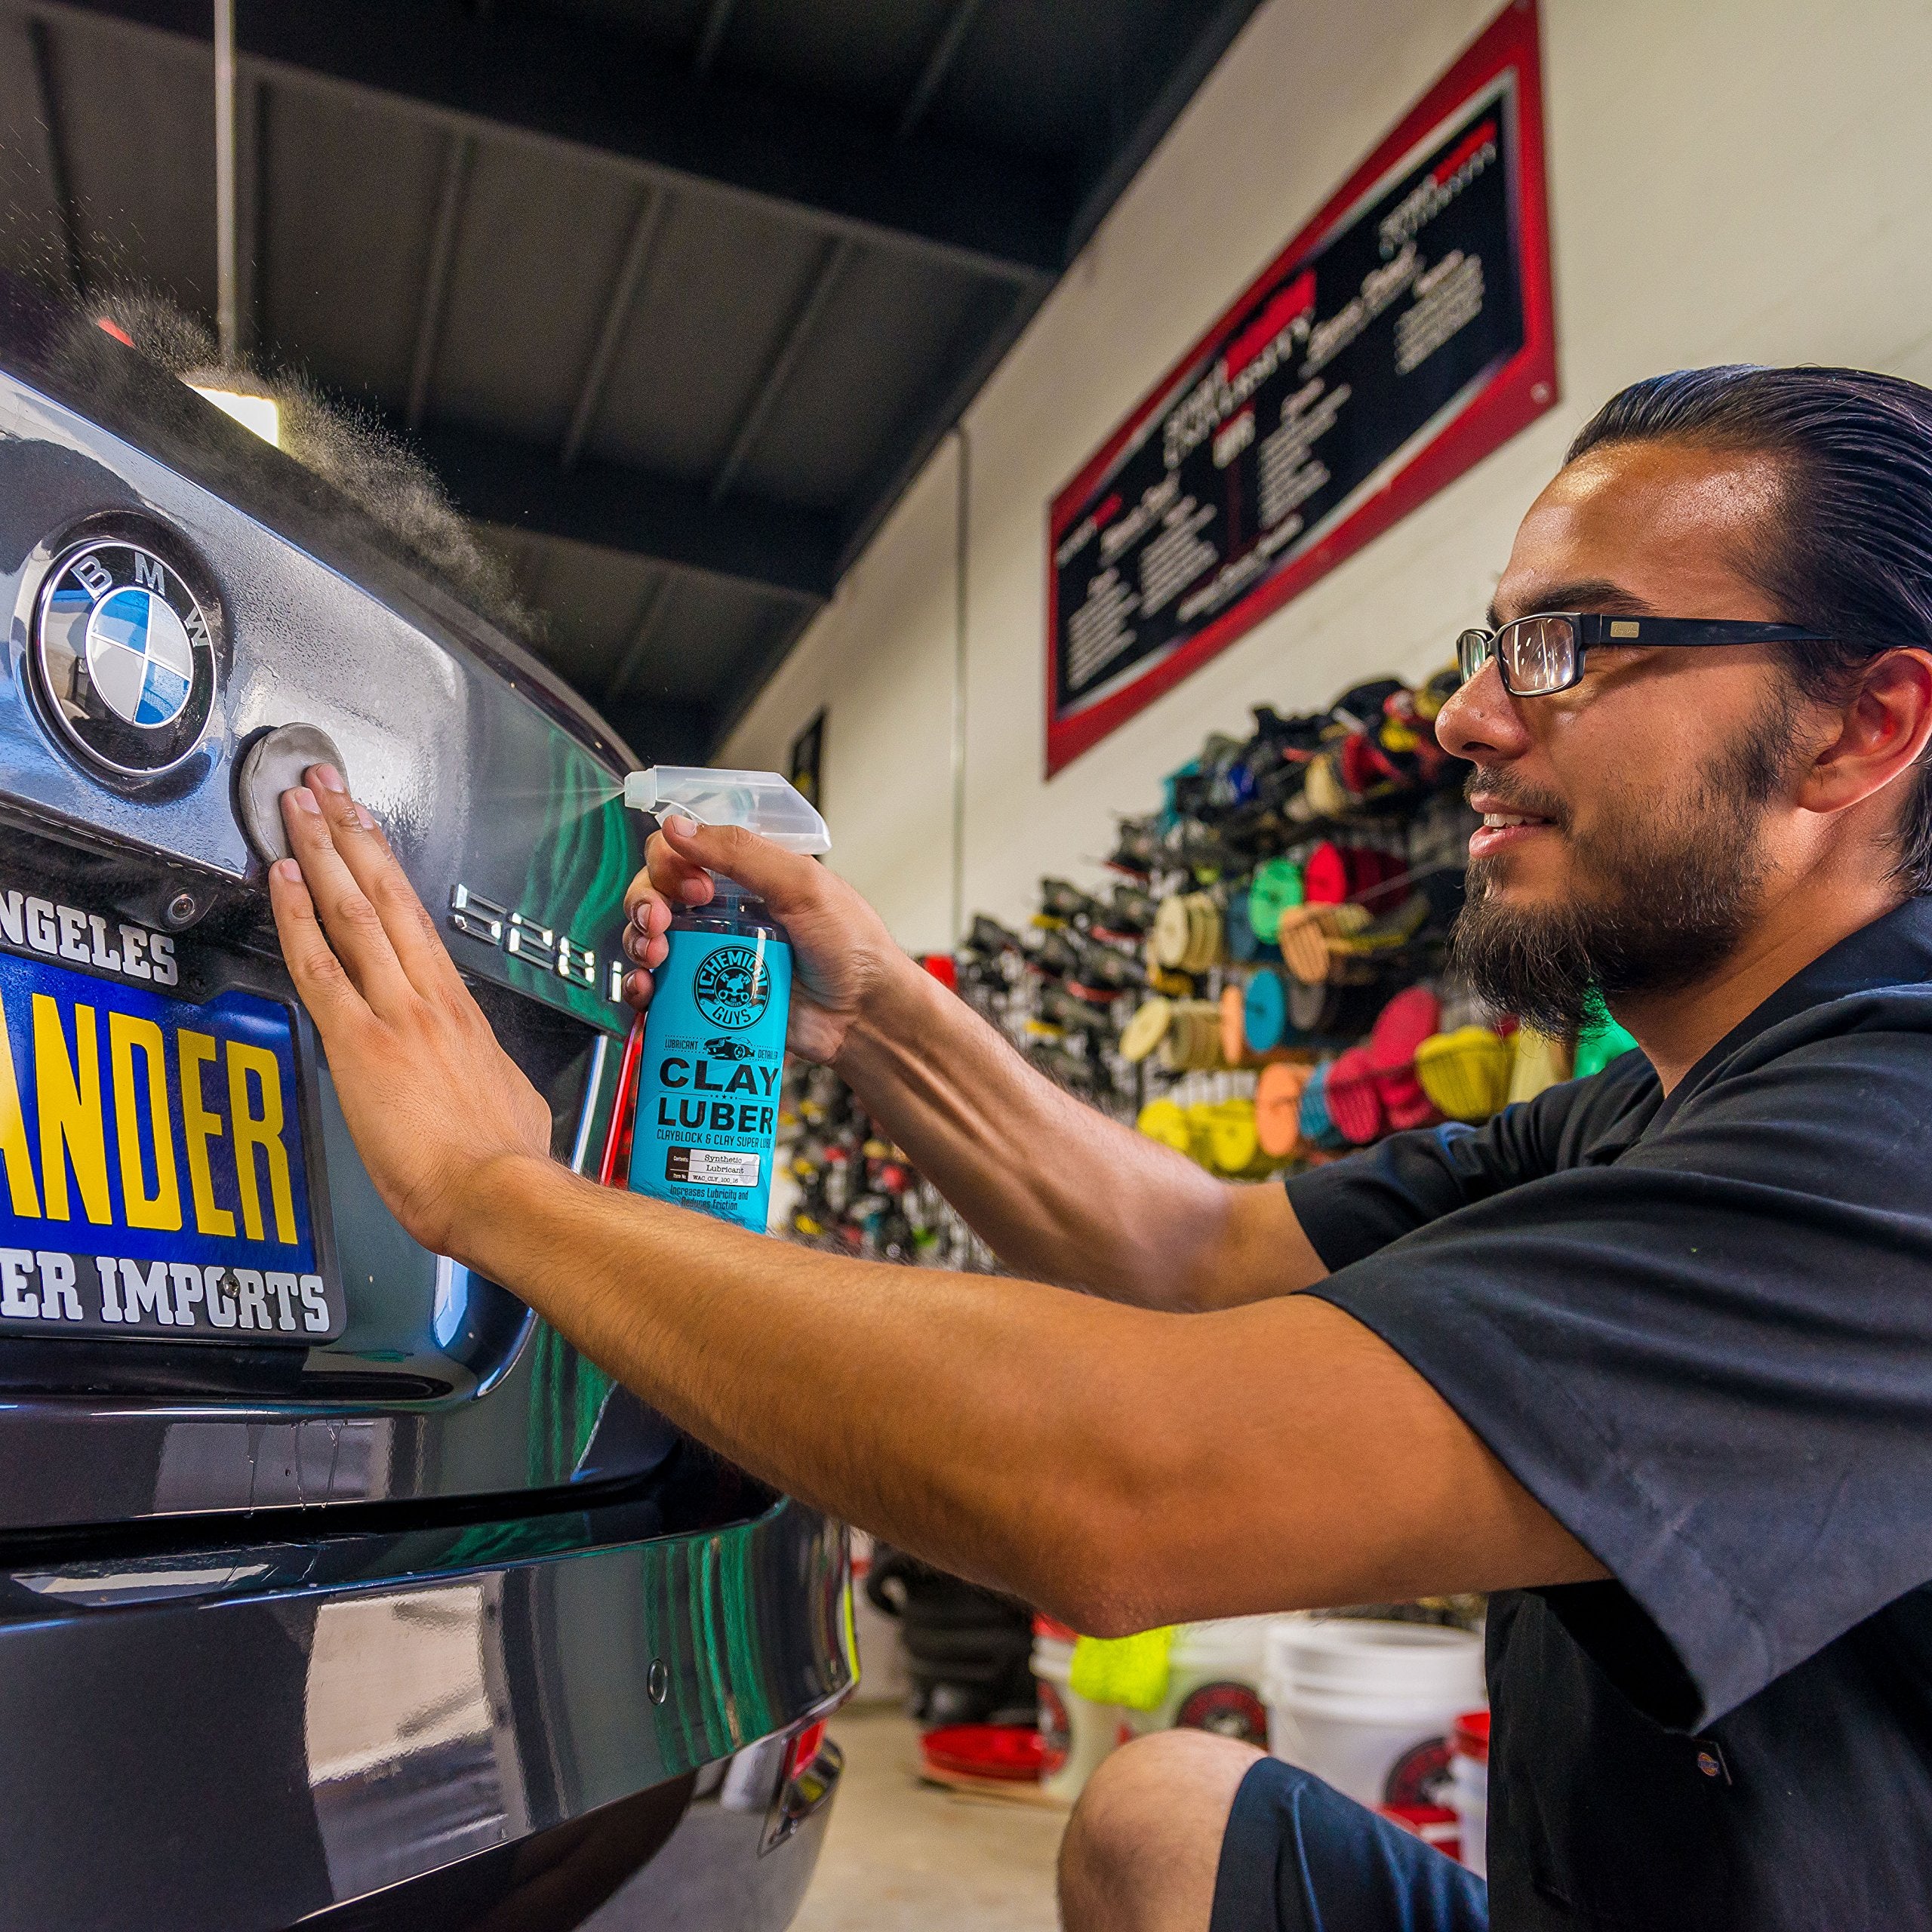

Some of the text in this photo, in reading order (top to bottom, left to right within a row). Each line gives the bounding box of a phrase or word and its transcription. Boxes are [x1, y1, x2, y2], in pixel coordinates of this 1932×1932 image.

[71, 552, 209, 648] BMW
[700, 951, 768, 991] CHEMICAL
[712, 1006, 752, 1025] GUYS
[665, 1038, 698, 1050] LUBRICANT
[659, 1057, 779, 1097] CLAY
[657, 1097, 774, 1134] LUBER
[657, 1129, 703, 1143] CLAYBLOCK
[705, 1134, 712, 1144] &
[714, 1134, 735, 1146] CLAY
[737, 1136, 758, 1148] SUPER
[704, 1154, 743, 1164] Synthetic
[706, 1164, 744, 1174] Lubricant
[670, 1184, 749, 1201] Increases Lubricity and
[712, 1199, 738, 1211] Friction
[0, 1248, 330, 1332] ER IMPORTS
